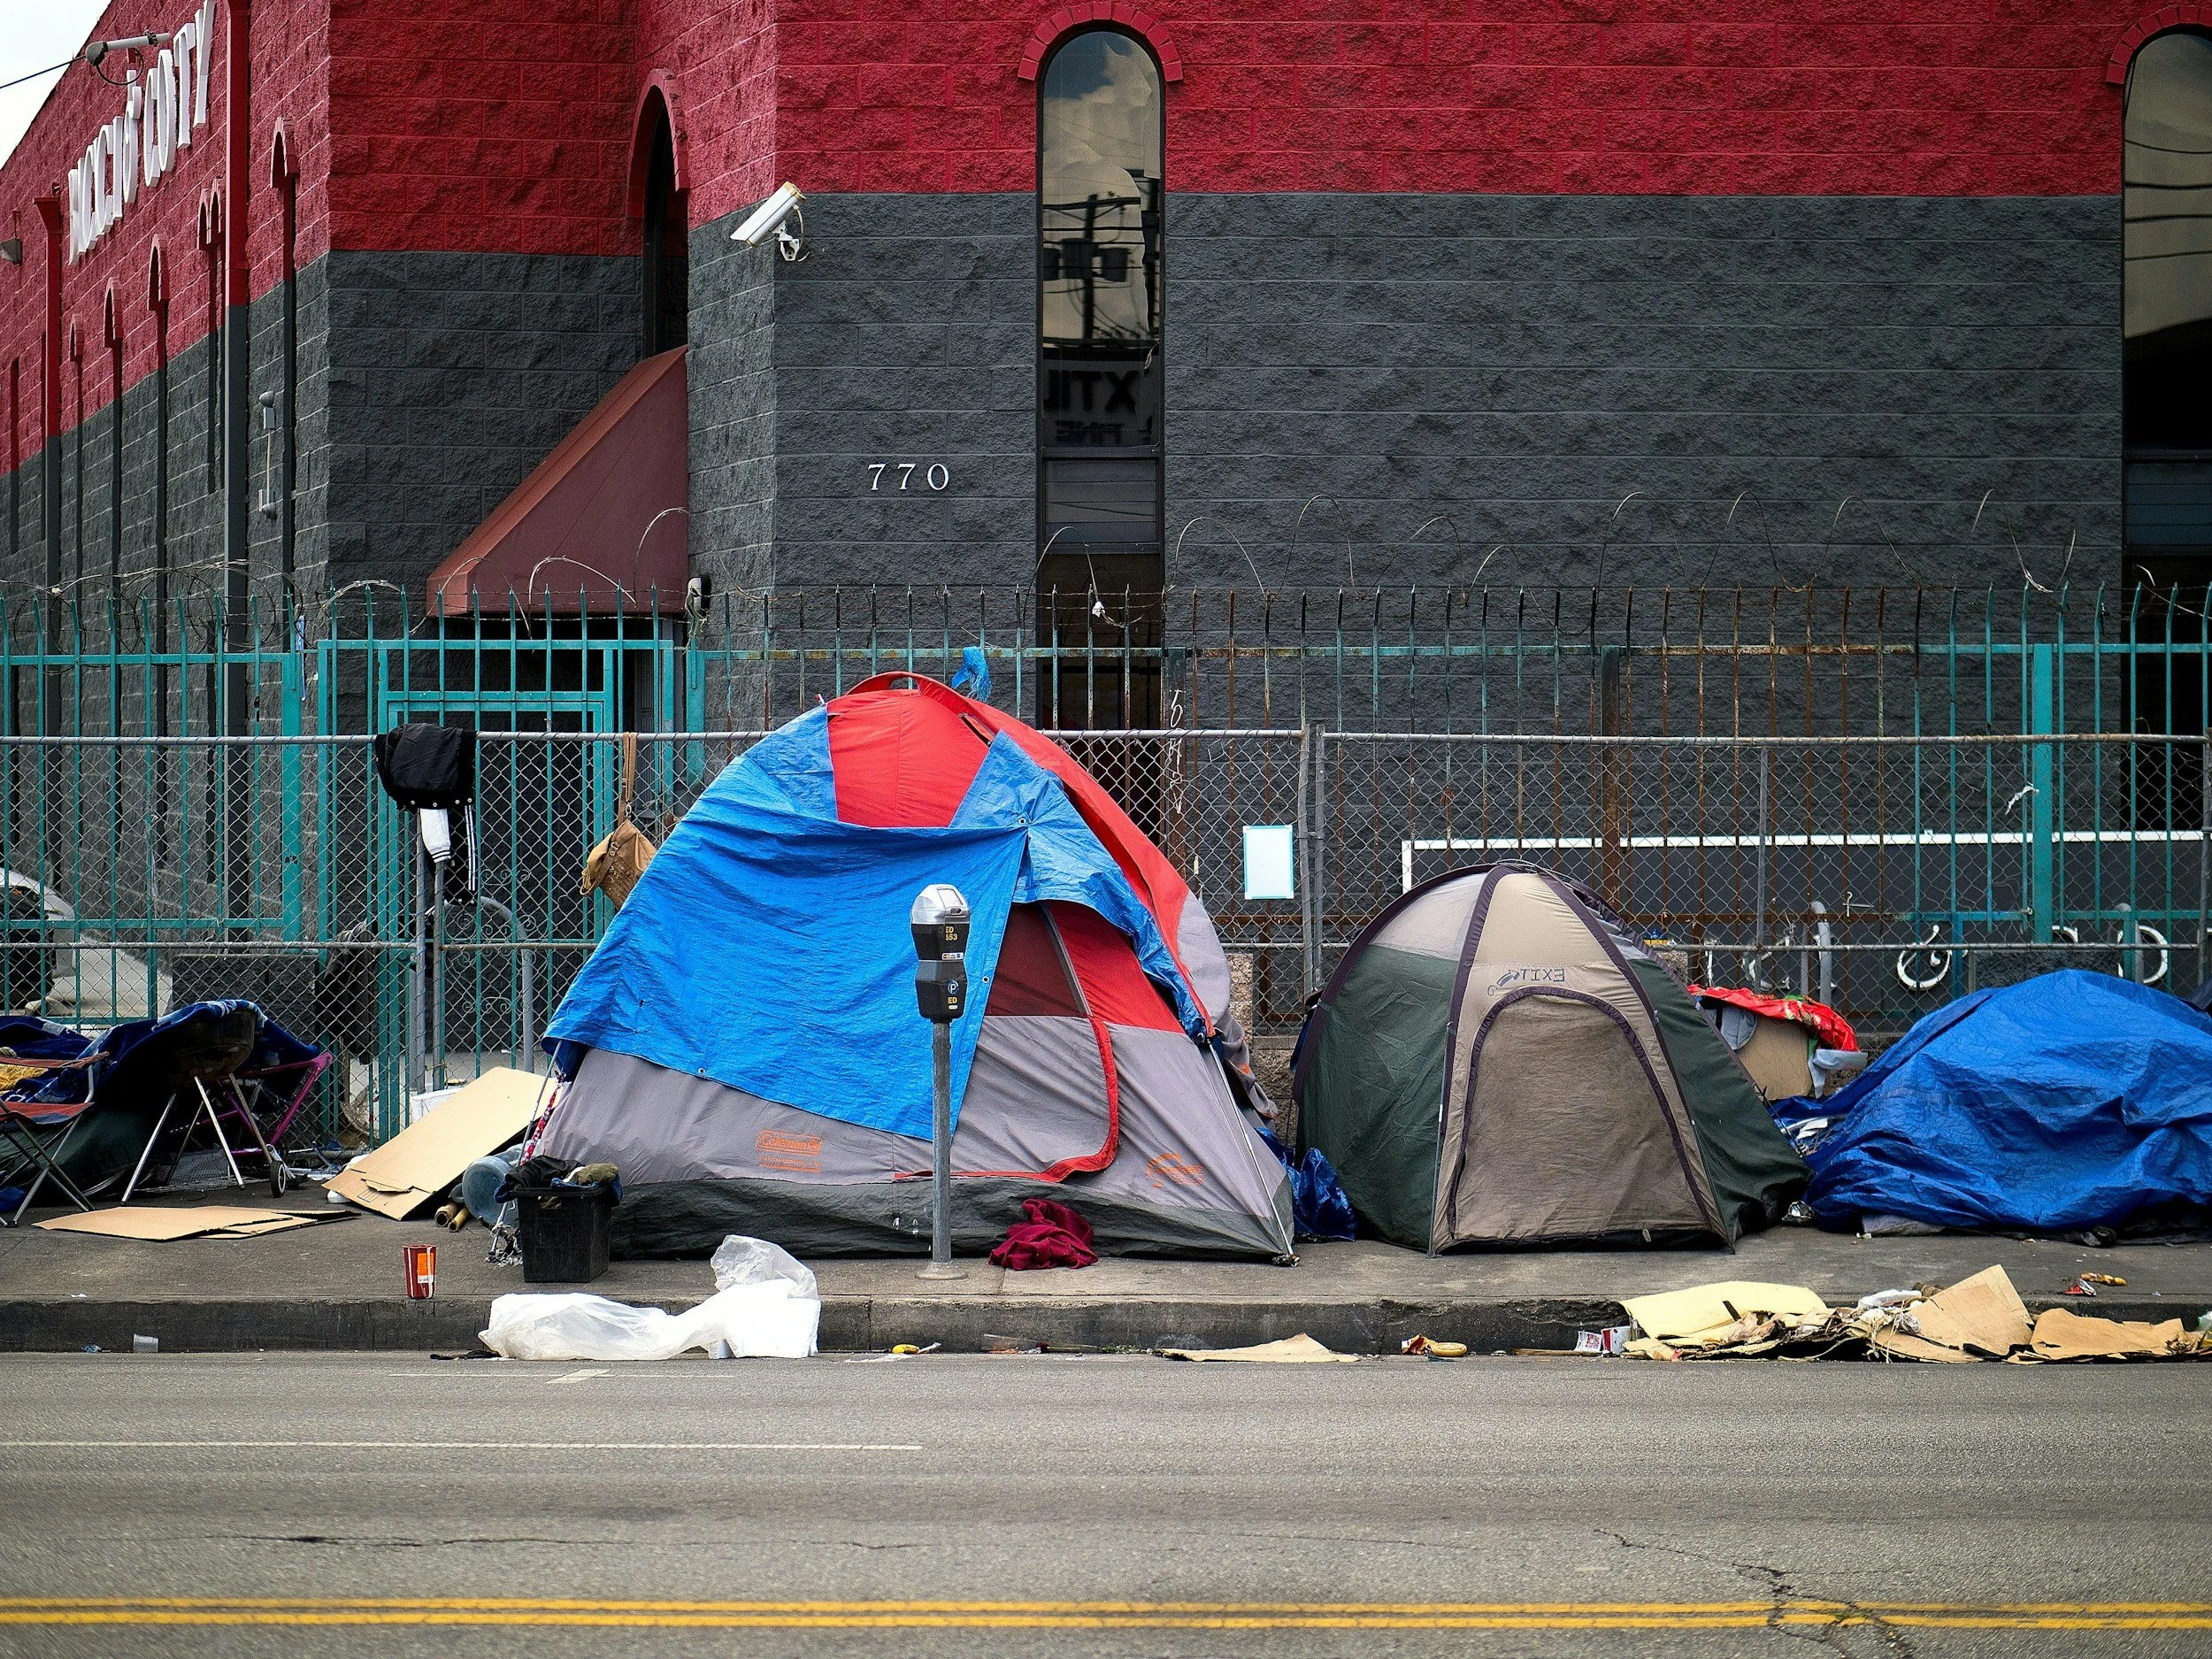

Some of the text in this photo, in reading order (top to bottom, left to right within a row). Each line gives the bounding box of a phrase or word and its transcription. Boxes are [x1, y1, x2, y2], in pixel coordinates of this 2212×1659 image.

[143, 0, 217, 187] COTY
[867, 463, 949, 491] 770
[762, 1133, 807, 1149] Coleman
